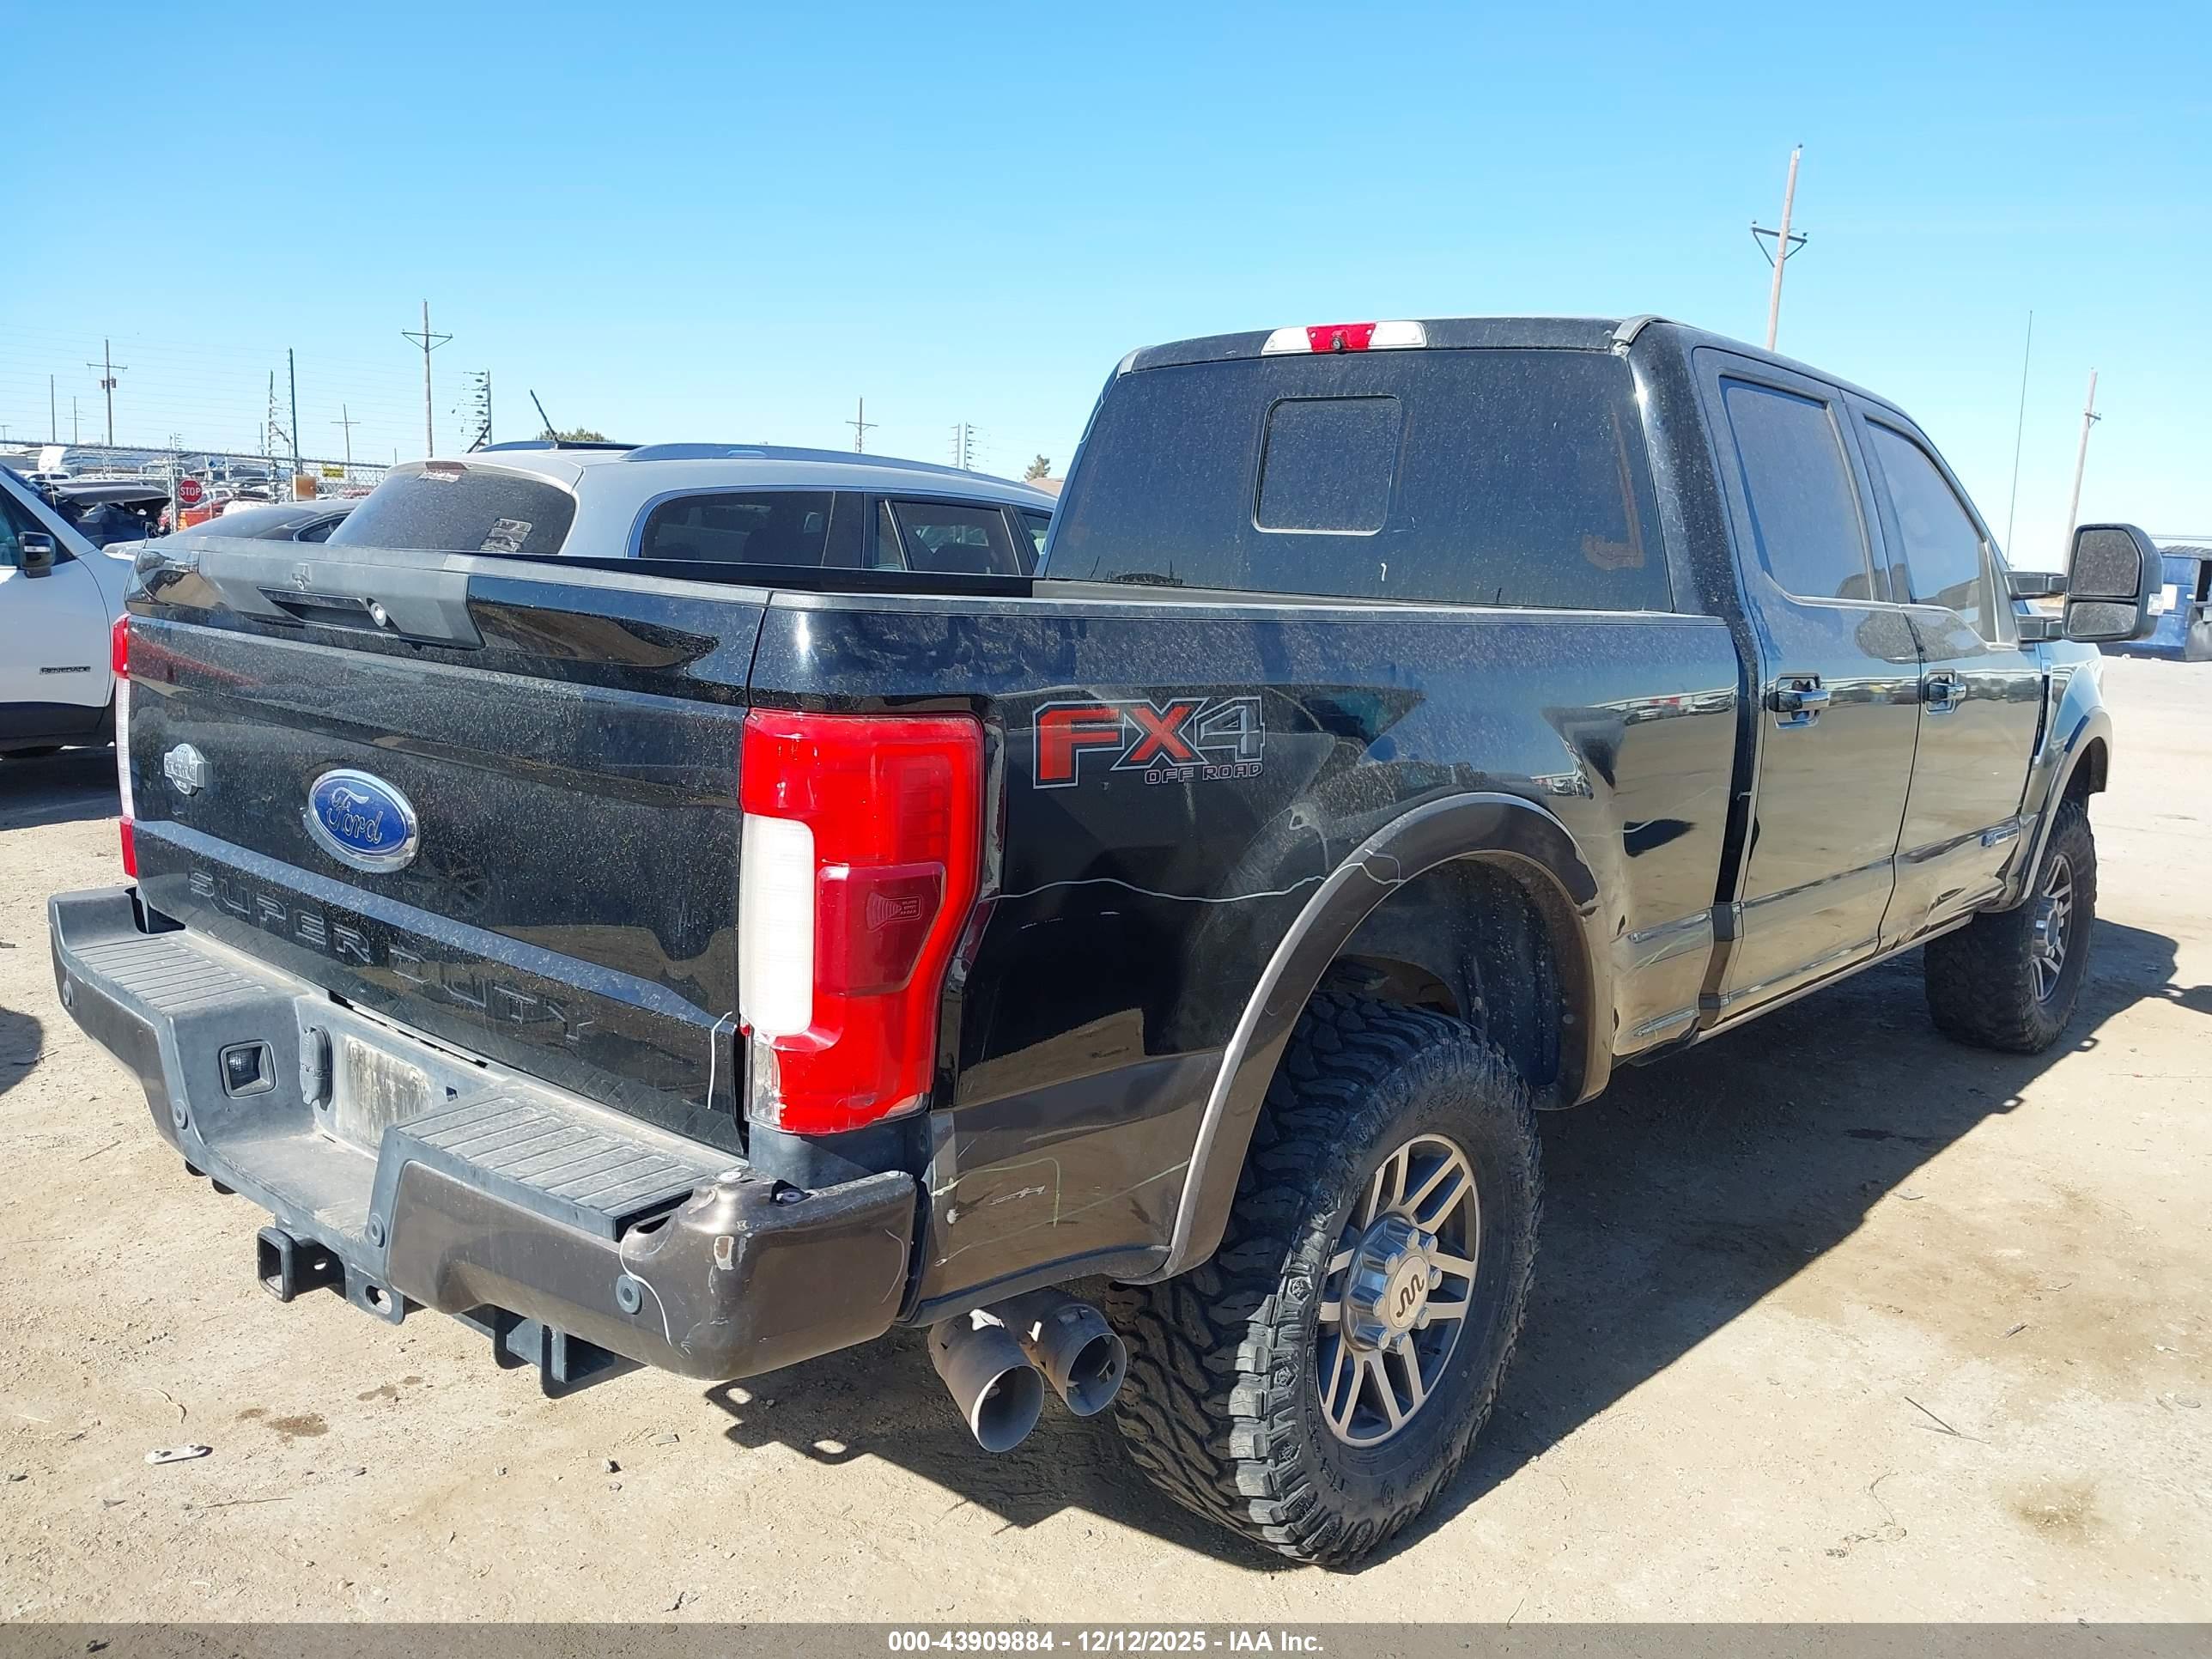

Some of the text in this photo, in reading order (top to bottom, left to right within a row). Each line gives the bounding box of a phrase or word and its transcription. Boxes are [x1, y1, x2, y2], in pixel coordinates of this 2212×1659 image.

[180, 486, 201, 496] STOP
[1032, 696, 1267, 789] FX4
[1144, 763, 1264, 785] OFF ROAD
[326, 787, 383, 845] Ford
[188, 868, 596, 1041] SUPER DUTY
